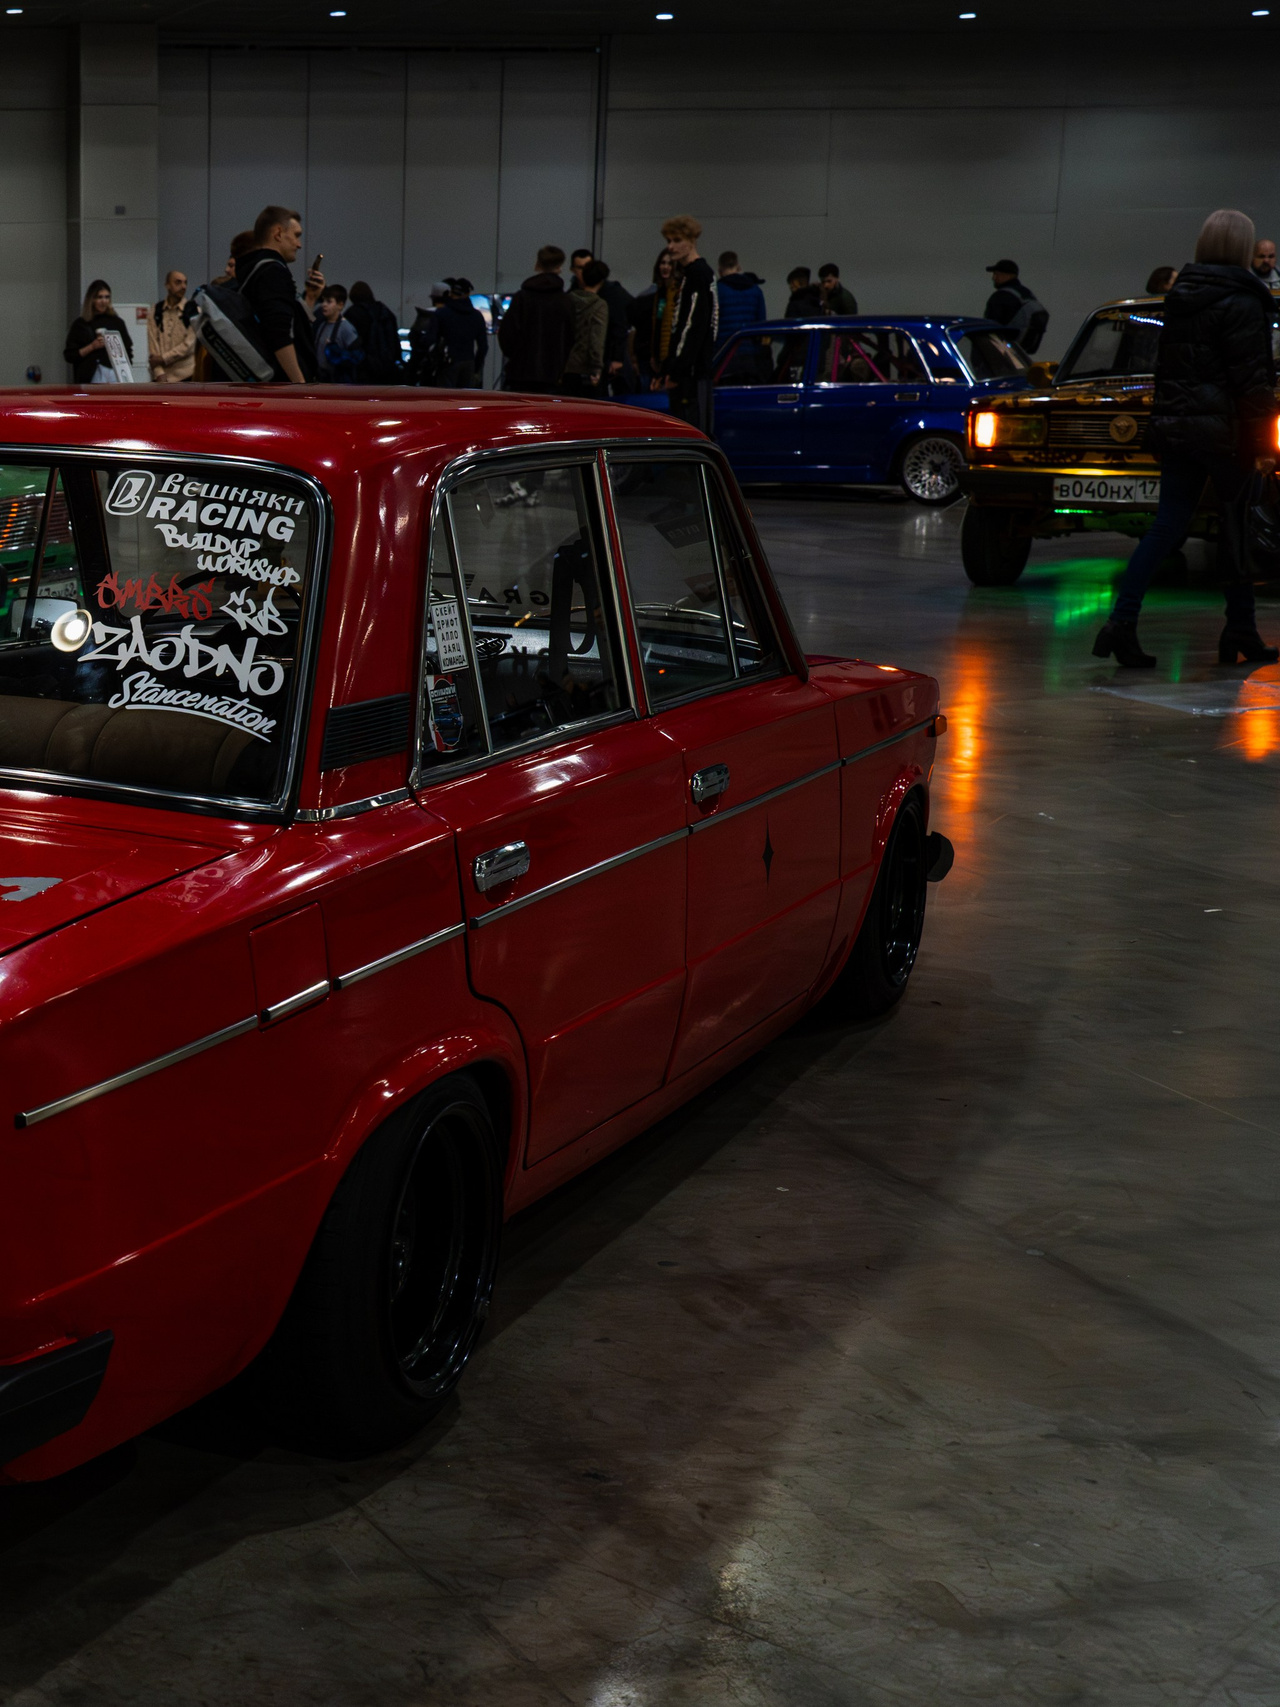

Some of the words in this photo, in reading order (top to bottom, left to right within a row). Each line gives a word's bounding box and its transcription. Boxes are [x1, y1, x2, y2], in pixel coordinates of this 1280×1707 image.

[1138, 480, 1161, 495] 17
[146, 496, 296, 543] RACING
[437, 617, 458, 630] ДРИФТ
[443, 643, 461, 654] ЗАЯЦ
[108, 671, 277, 734] Stancenation
